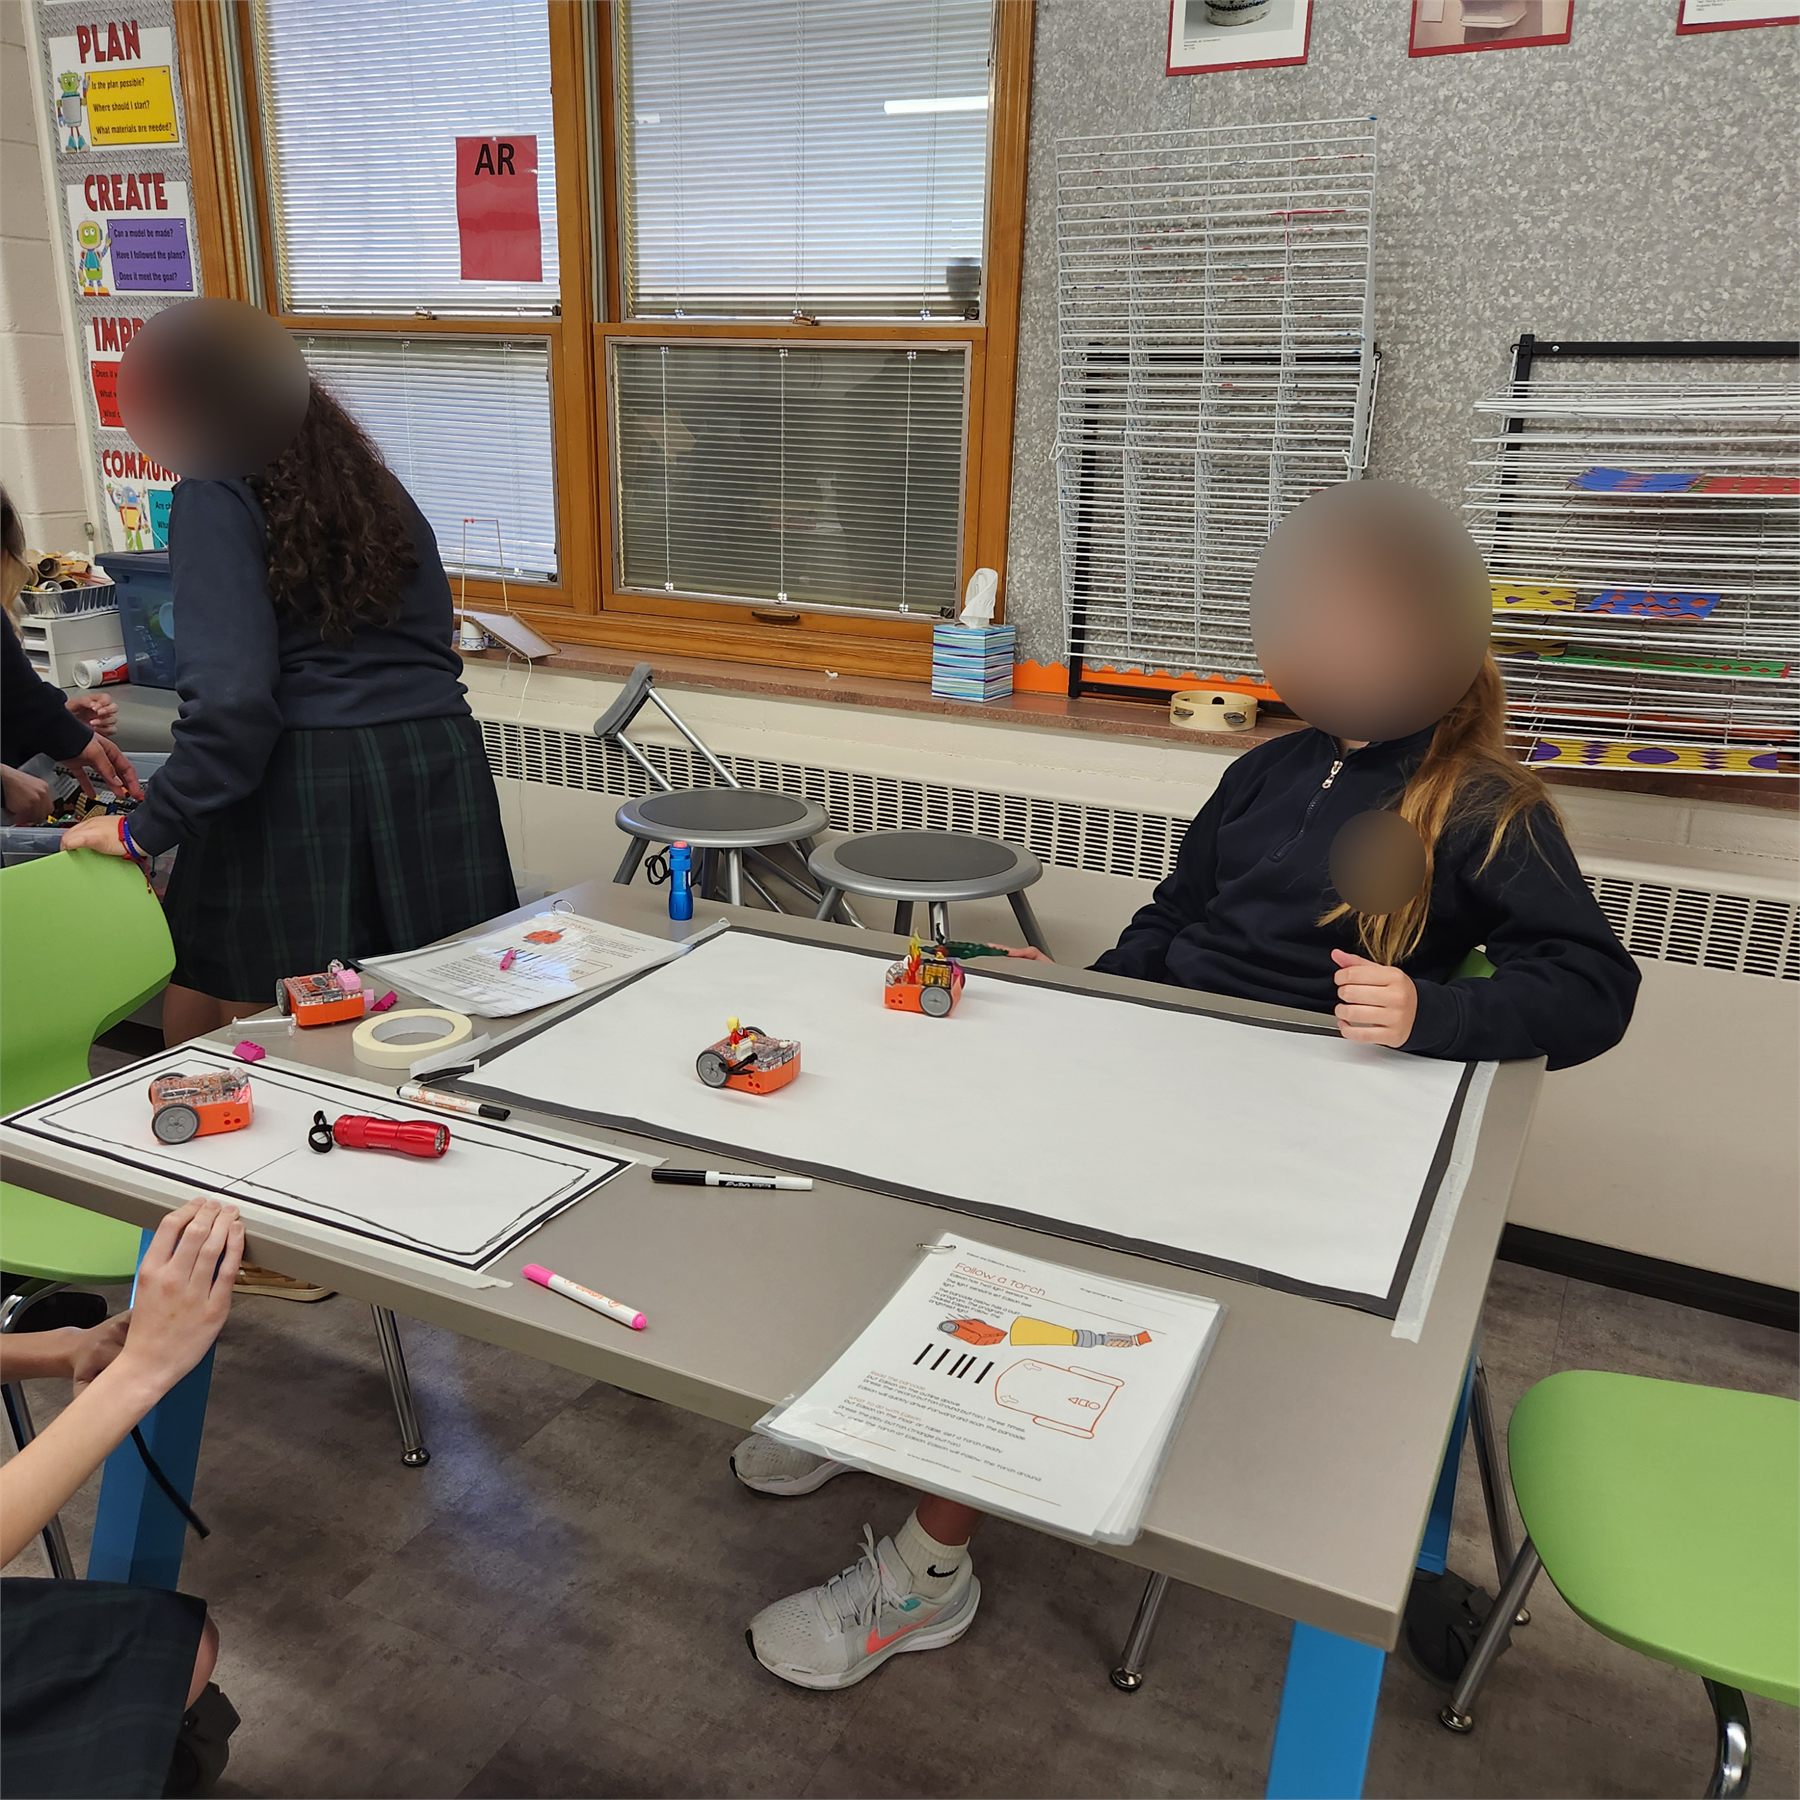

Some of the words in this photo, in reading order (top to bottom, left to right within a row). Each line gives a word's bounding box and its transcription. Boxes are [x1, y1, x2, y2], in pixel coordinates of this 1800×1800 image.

[77, 20, 141, 63] PLAN
[92, 82, 96, 90] Is
[98, 81, 106, 89] the
[108, 80, 118, 90] plan
[120, 78, 144, 89] possible?
[92, 104, 110, 112] Where
[112, 102, 129, 111] should
[134, 100, 149, 109] start?
[96, 126, 110, 134] What
[112, 124, 136, 133] materials
[148, 122, 172, 132] needed?
[474, 144, 515, 175] AR
[84, 173, 168, 211] CREATE
[114, 229, 124, 237] Can
[155, 228, 173, 237] made?
[134, 251, 156, 259] followed
[158, 251, 166, 259] the
[168, 250, 185, 260] plans?
[119, 272, 132, 280] Does
[163, 272, 177, 282] goal?
[955, 1262, 996, 1280] Follow
[1010, 1280, 1046, 1296] torch
